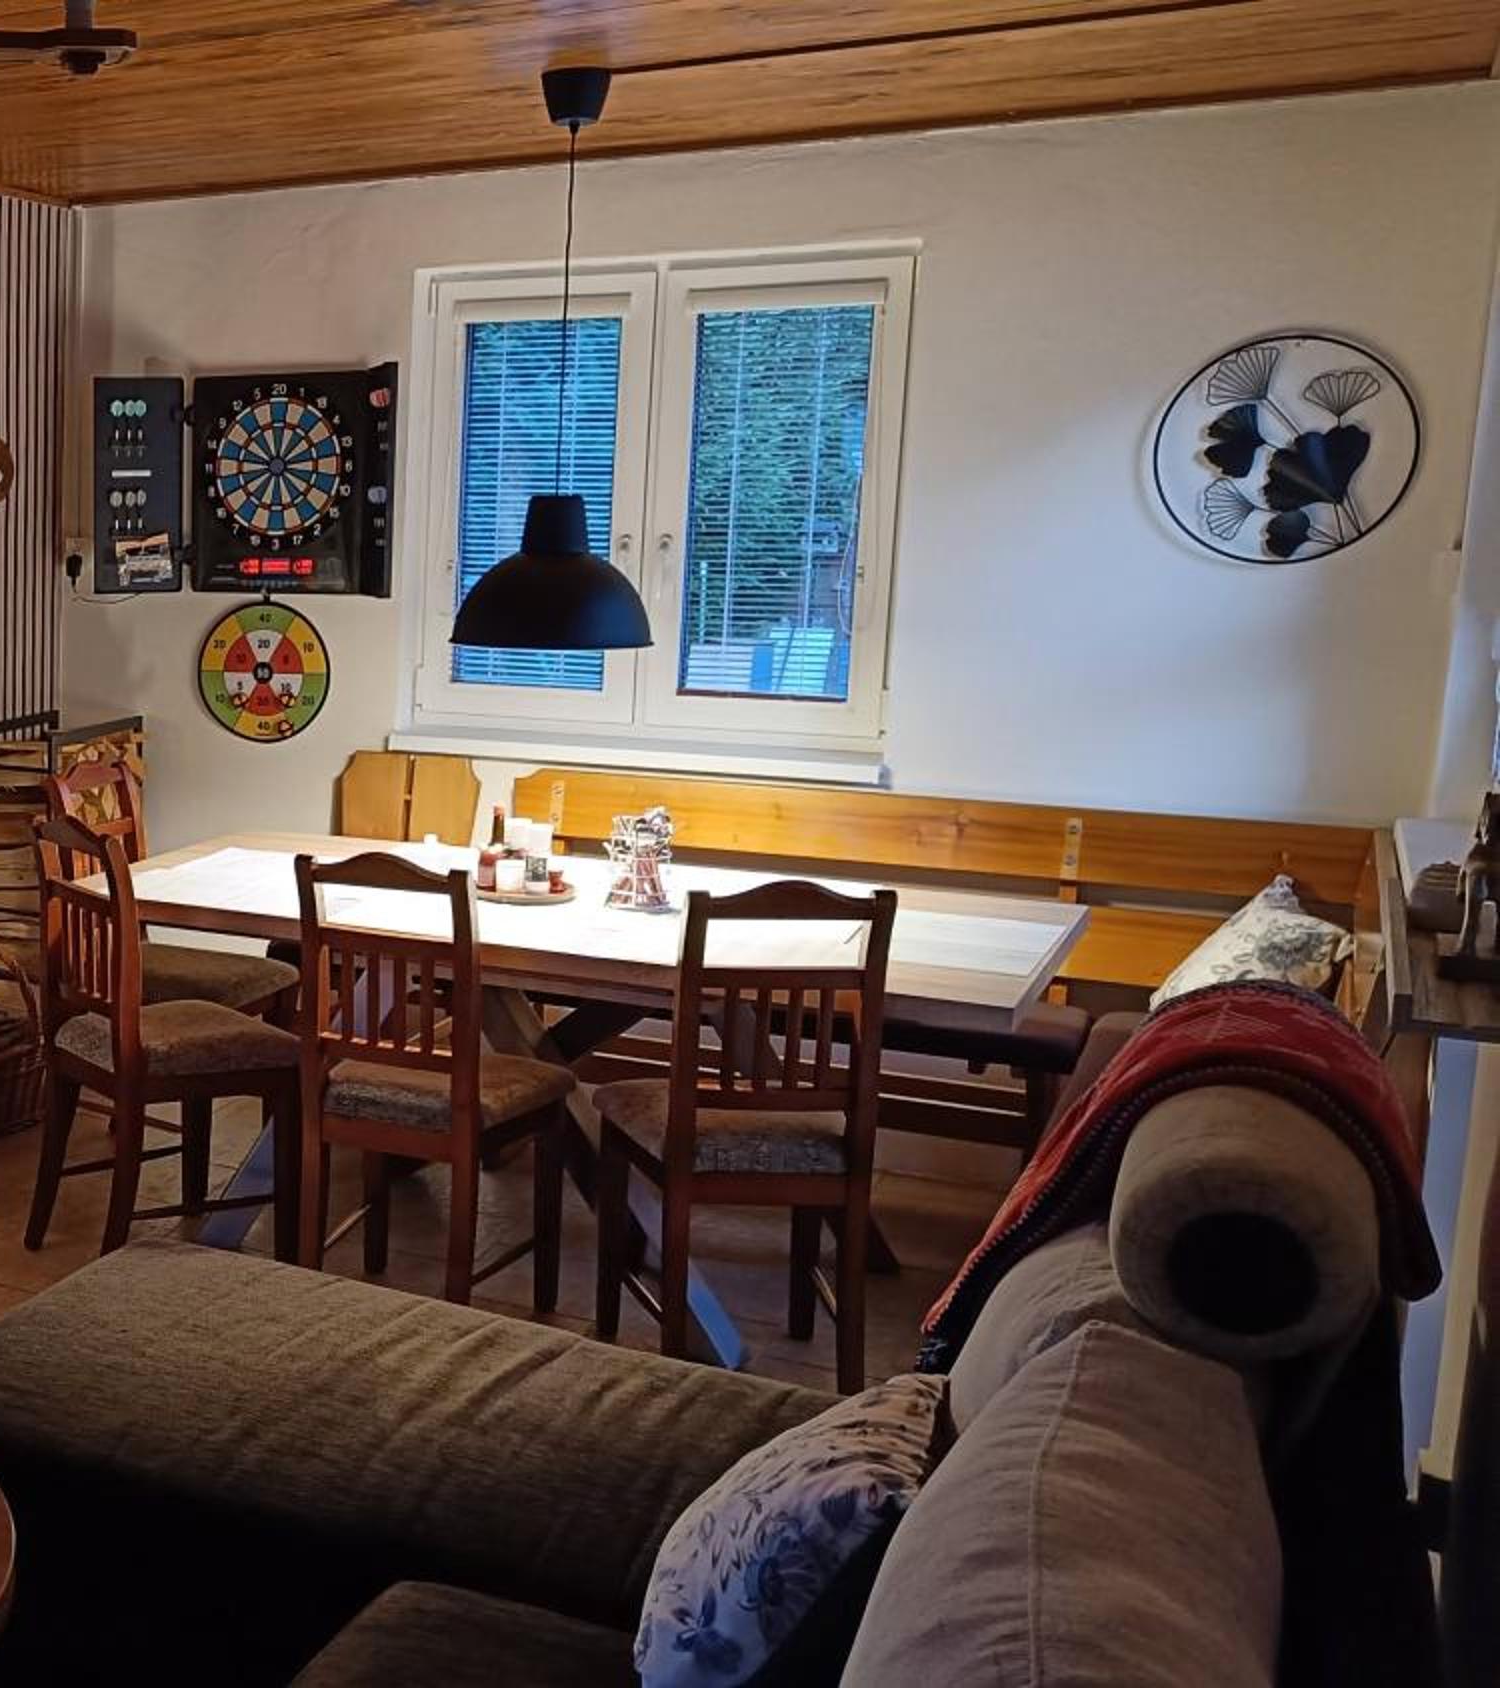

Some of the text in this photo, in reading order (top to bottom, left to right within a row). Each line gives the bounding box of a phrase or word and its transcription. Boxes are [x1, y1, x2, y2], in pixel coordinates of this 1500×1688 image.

[271, 383, 287, 396] 20
[339, 484, 351, 497] 10
[292, 534, 304, 545] 17
[259, 612, 272, 623] 40
